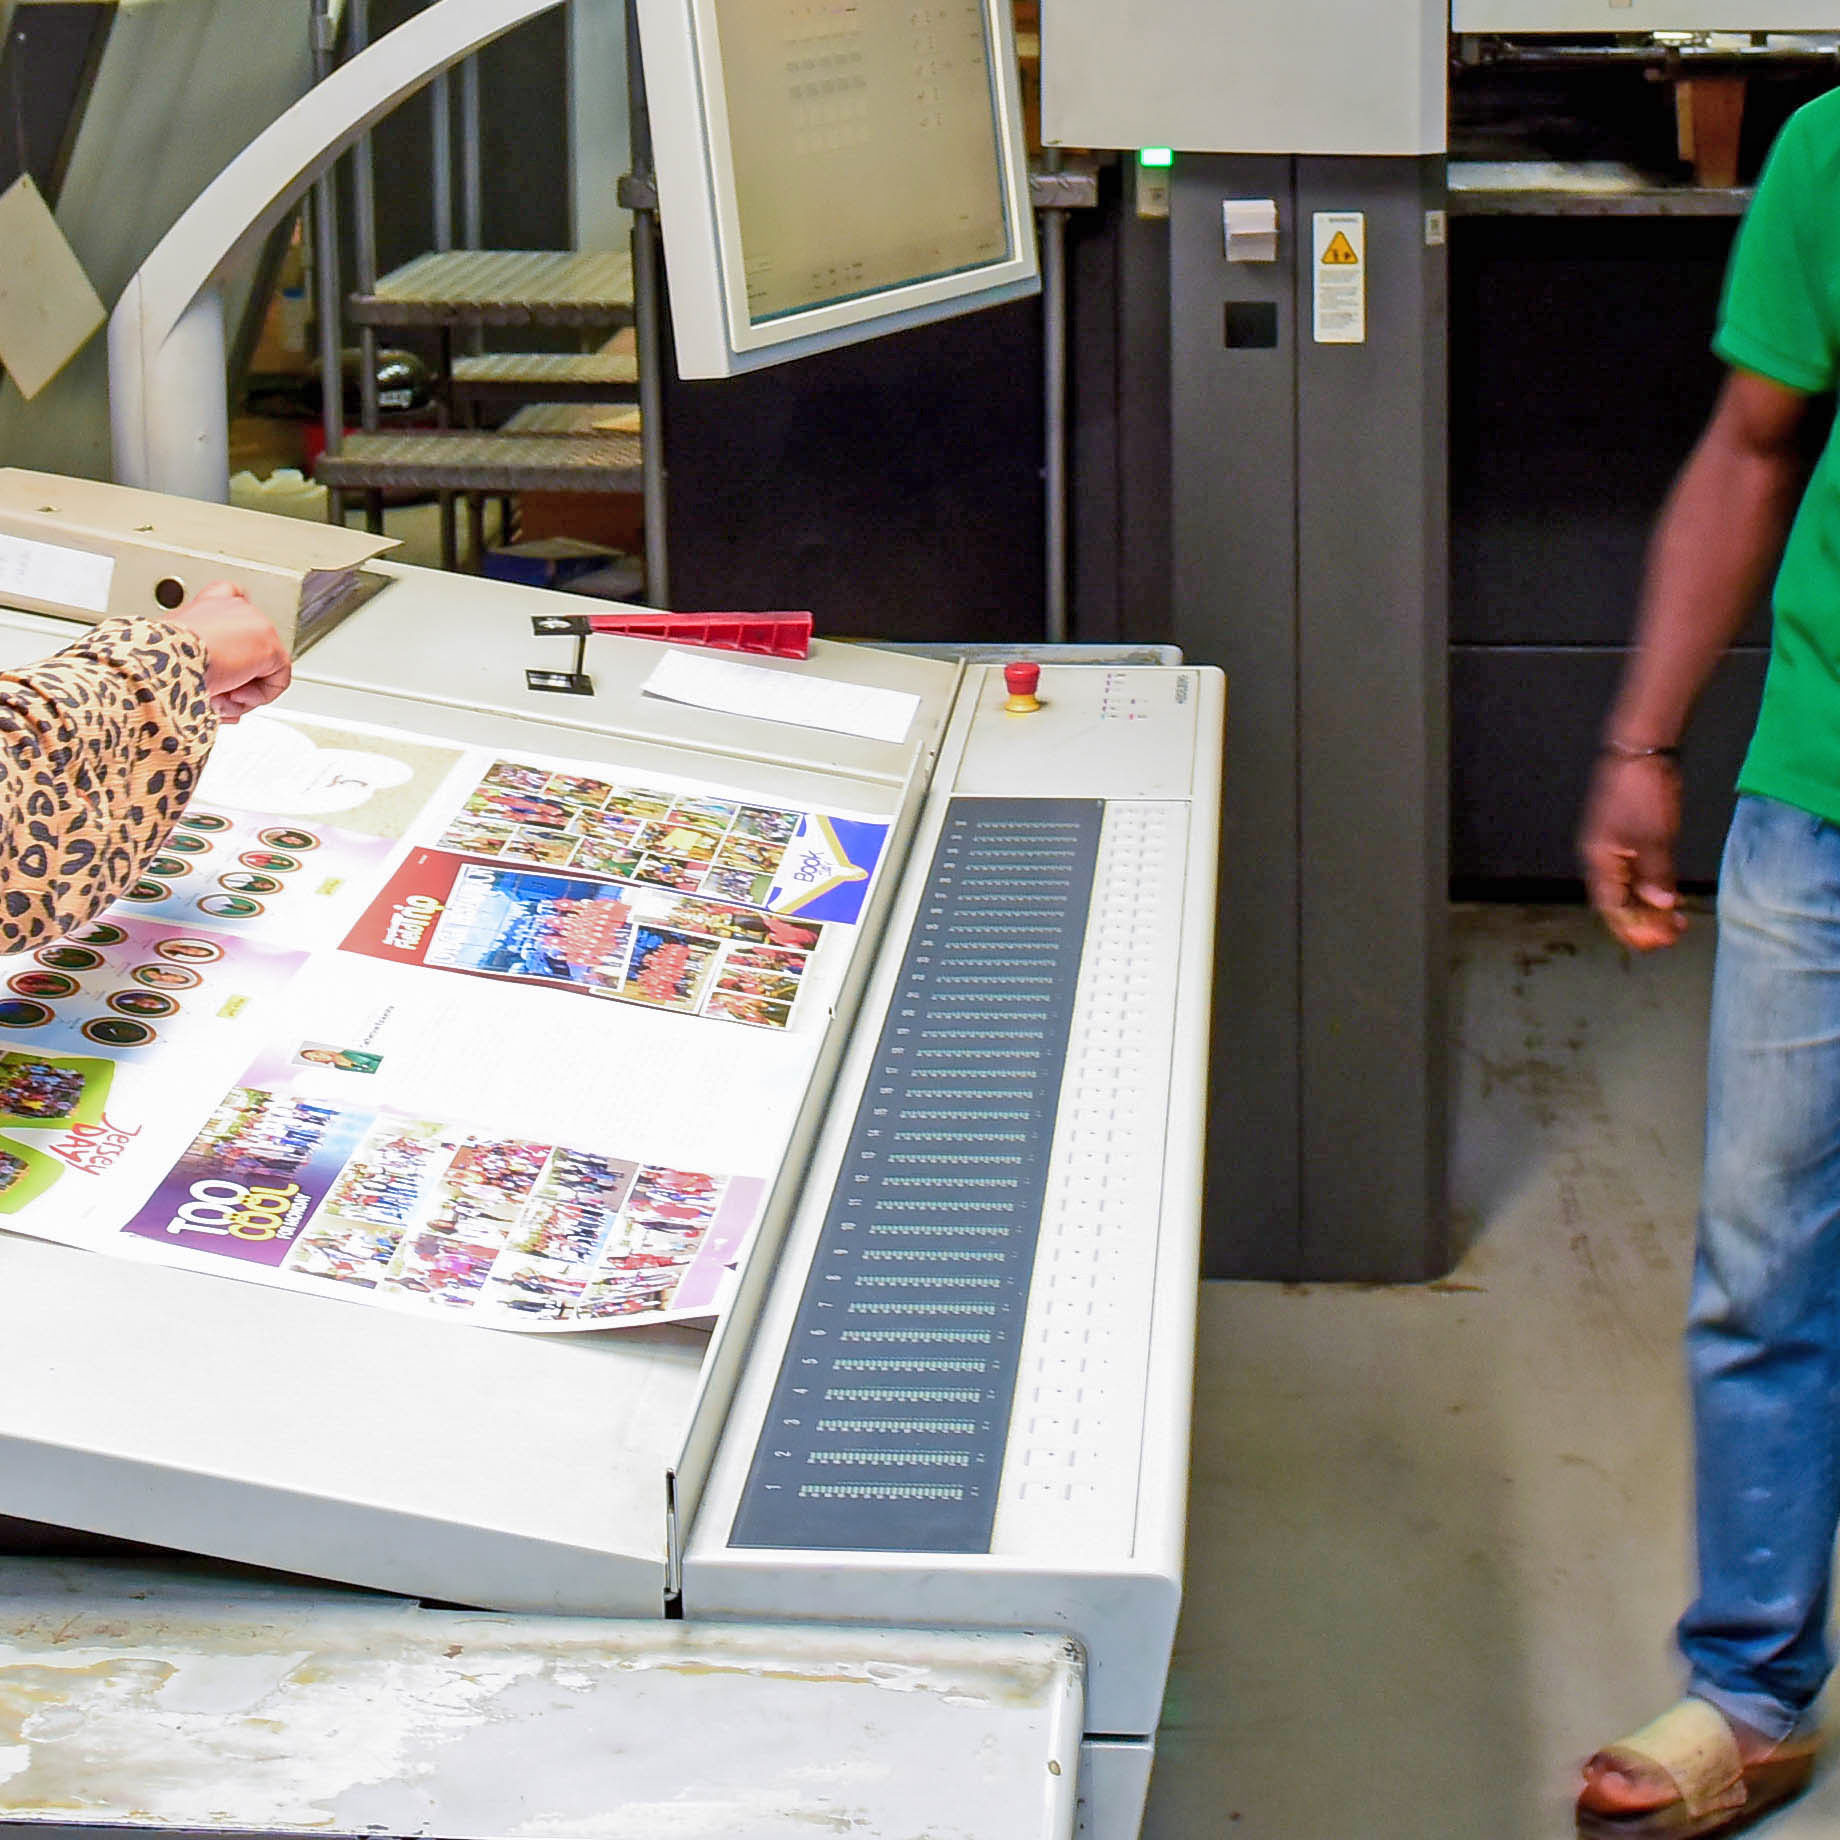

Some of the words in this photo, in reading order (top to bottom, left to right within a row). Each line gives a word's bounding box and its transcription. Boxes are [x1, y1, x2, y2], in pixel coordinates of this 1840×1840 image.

[793, 850, 825, 883] Book
[48, 1122, 109, 1163] DAY
[64, 1112, 143, 1176] Jersey
[166, 1178, 251, 1236] TOO
[224, 1182, 301, 1242] COOL
[284, 1192, 313, 1227] MONDAY
[276, 1224, 294, 1240] FOR
